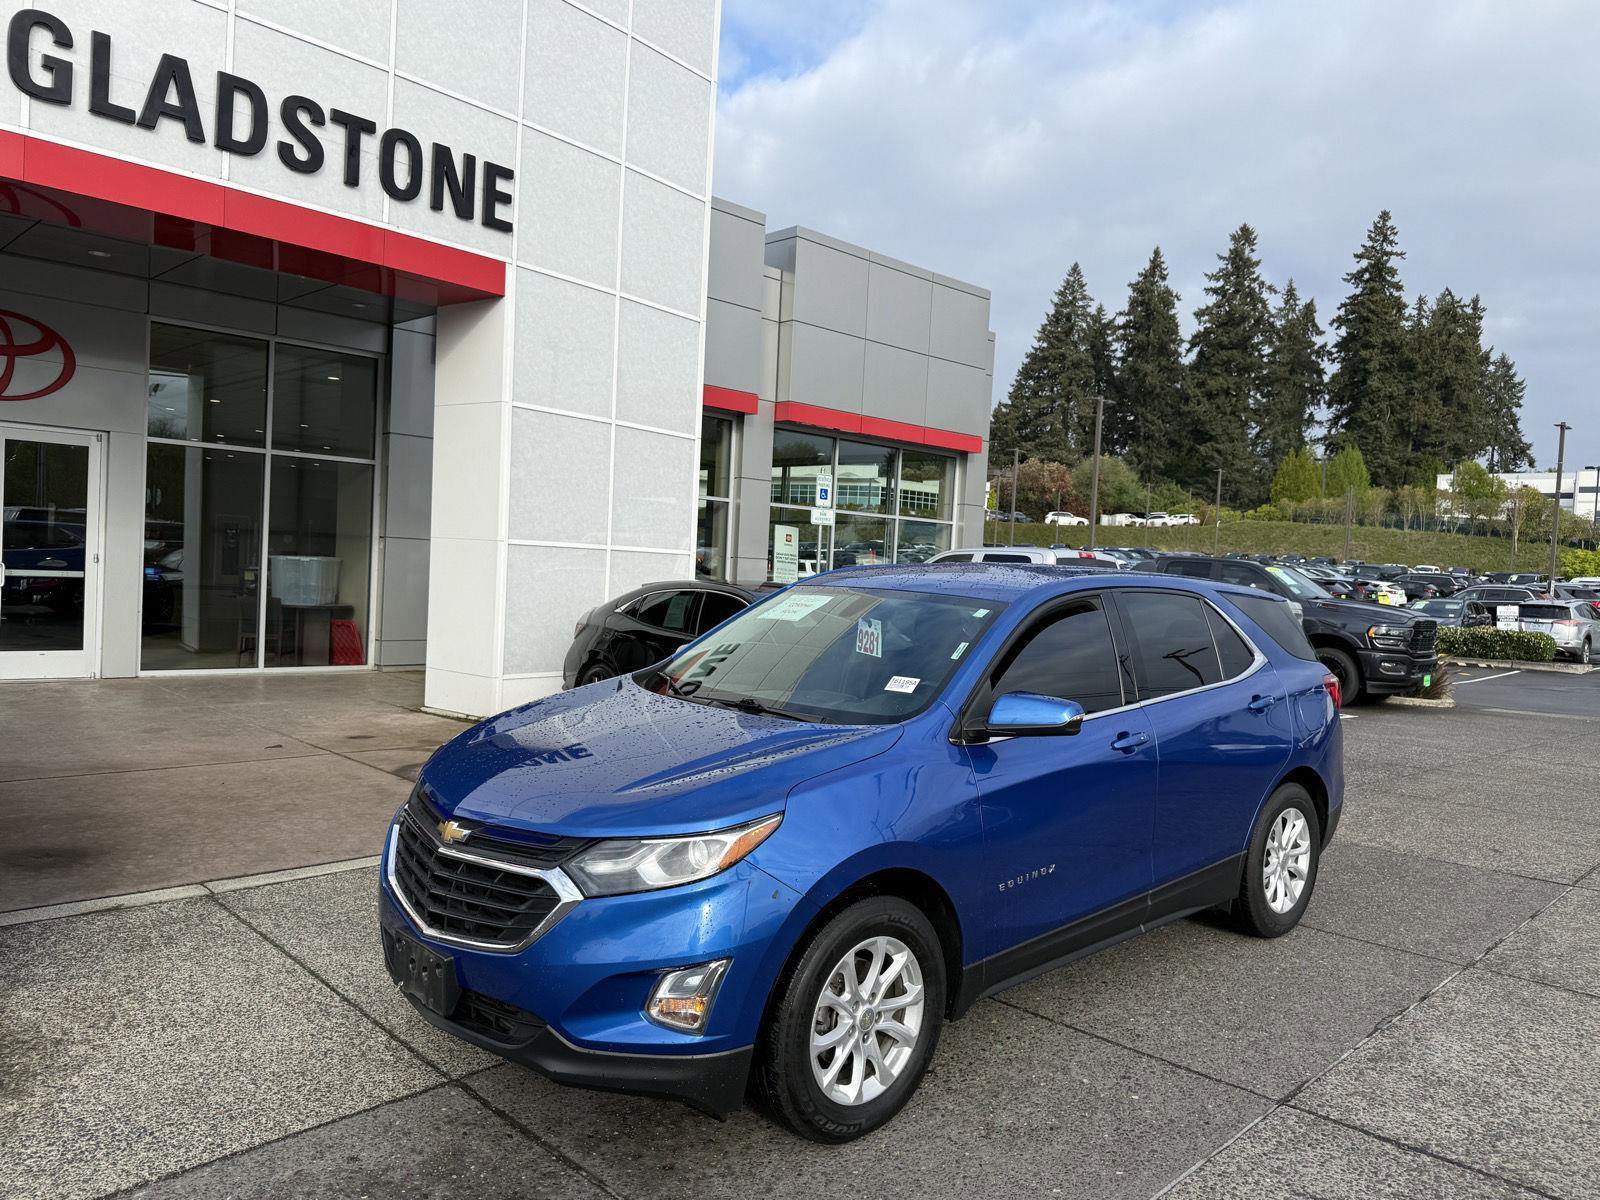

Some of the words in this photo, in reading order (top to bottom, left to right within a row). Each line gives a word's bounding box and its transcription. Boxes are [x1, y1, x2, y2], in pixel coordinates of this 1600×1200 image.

[7, 8, 514, 233] GLADSTONE
[857, 628, 879, 656] 9281
[998, 863, 1056, 892] EQUINOX
